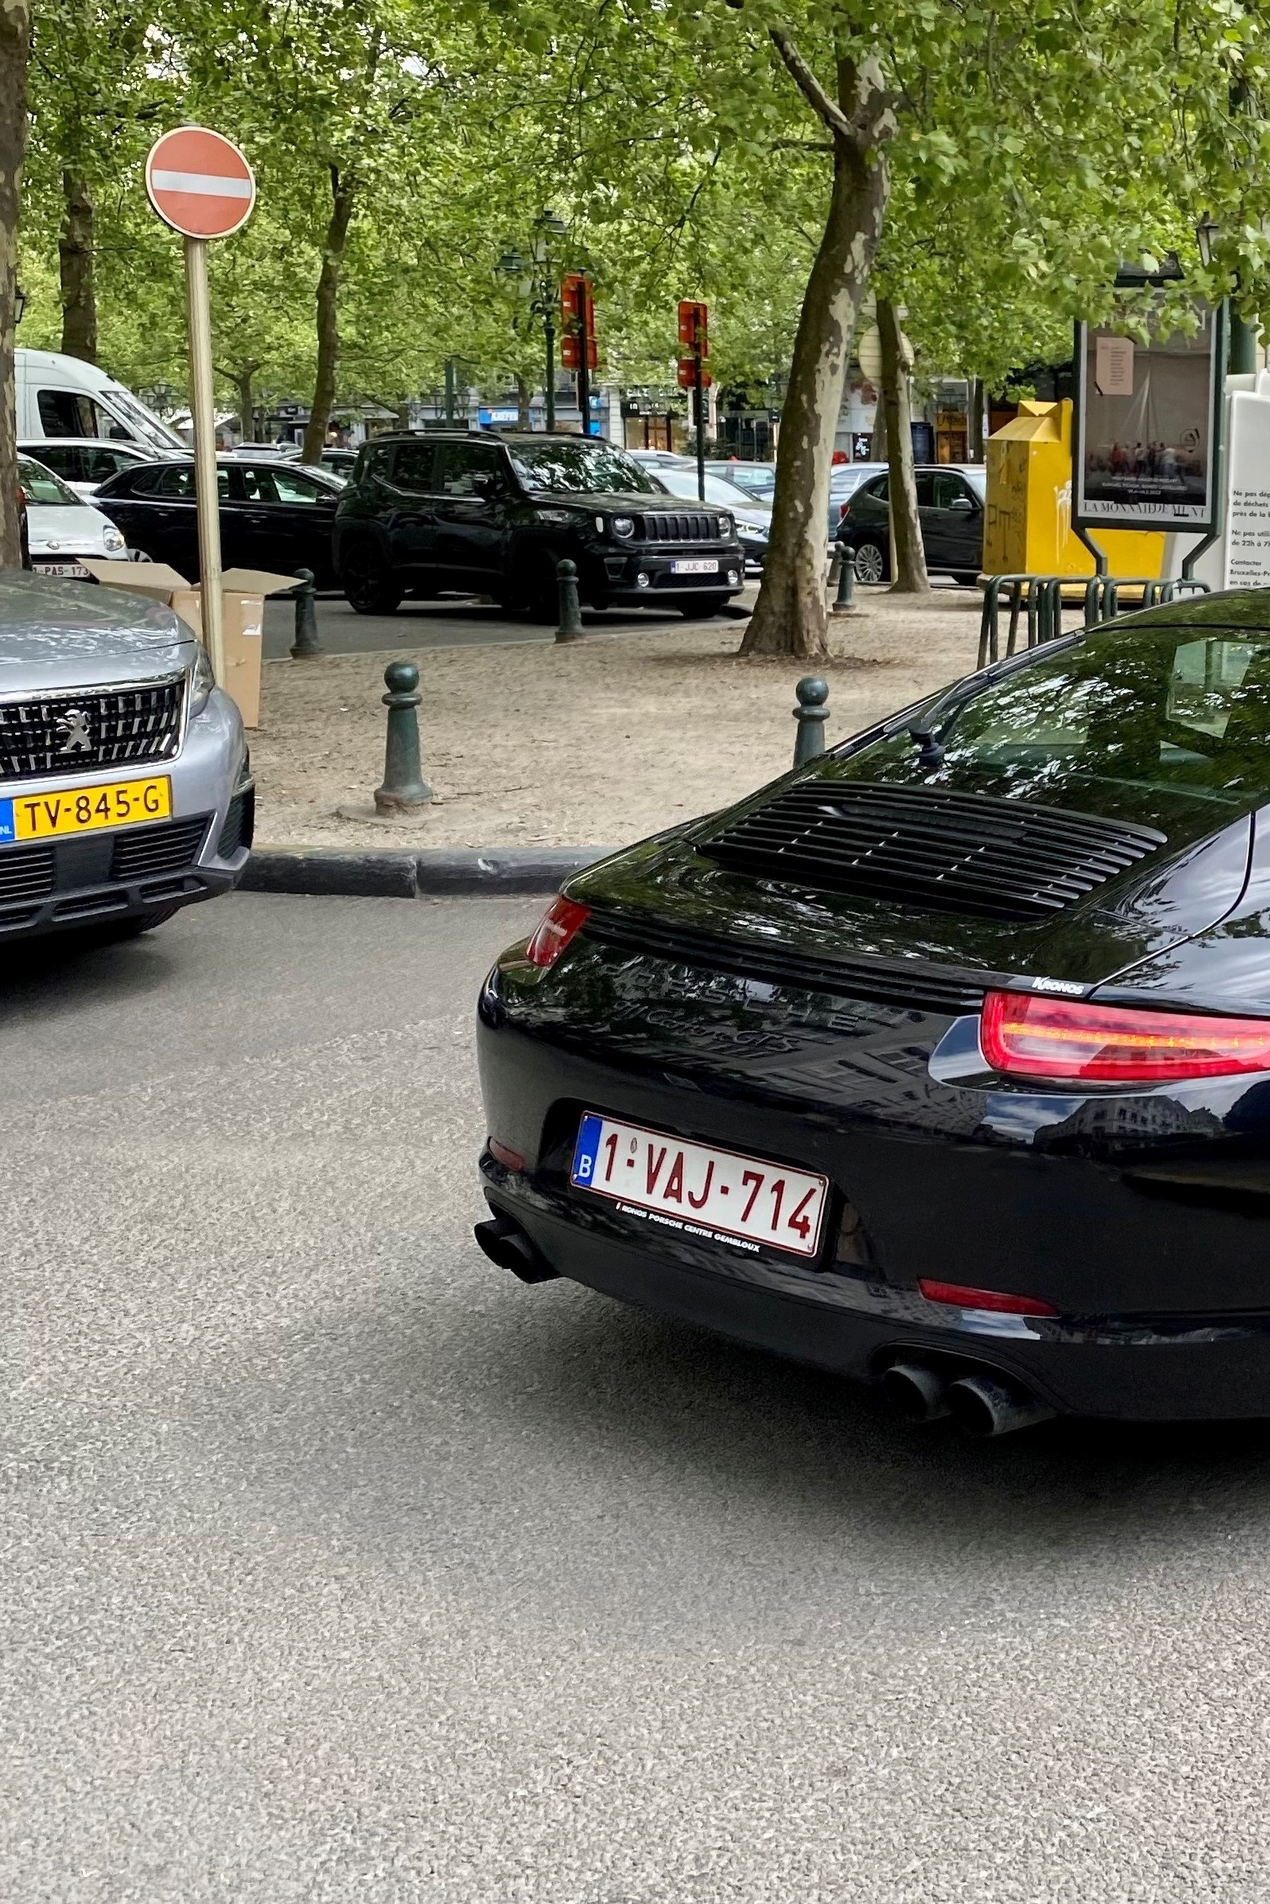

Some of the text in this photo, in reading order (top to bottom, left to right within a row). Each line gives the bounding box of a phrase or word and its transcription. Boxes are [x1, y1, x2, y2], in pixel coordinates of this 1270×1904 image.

[1245, 491, 1257, 499] pas
[1243, 530, 1255, 538] pas
[24, 785, 159, 831] TV-845-G
[0, 825, 12, 834] NL
[733, 1030, 801, 1053] GTS
[578, 1154, 592, 1178] B
[605, 1133, 817, 1239] 1-VAJ-714
[648, 1213, 684, 1229] PORSCHE
[684, 1224, 713, 1238] CENTRE
[714, 1233, 761, 1253] GEMBLOUX
